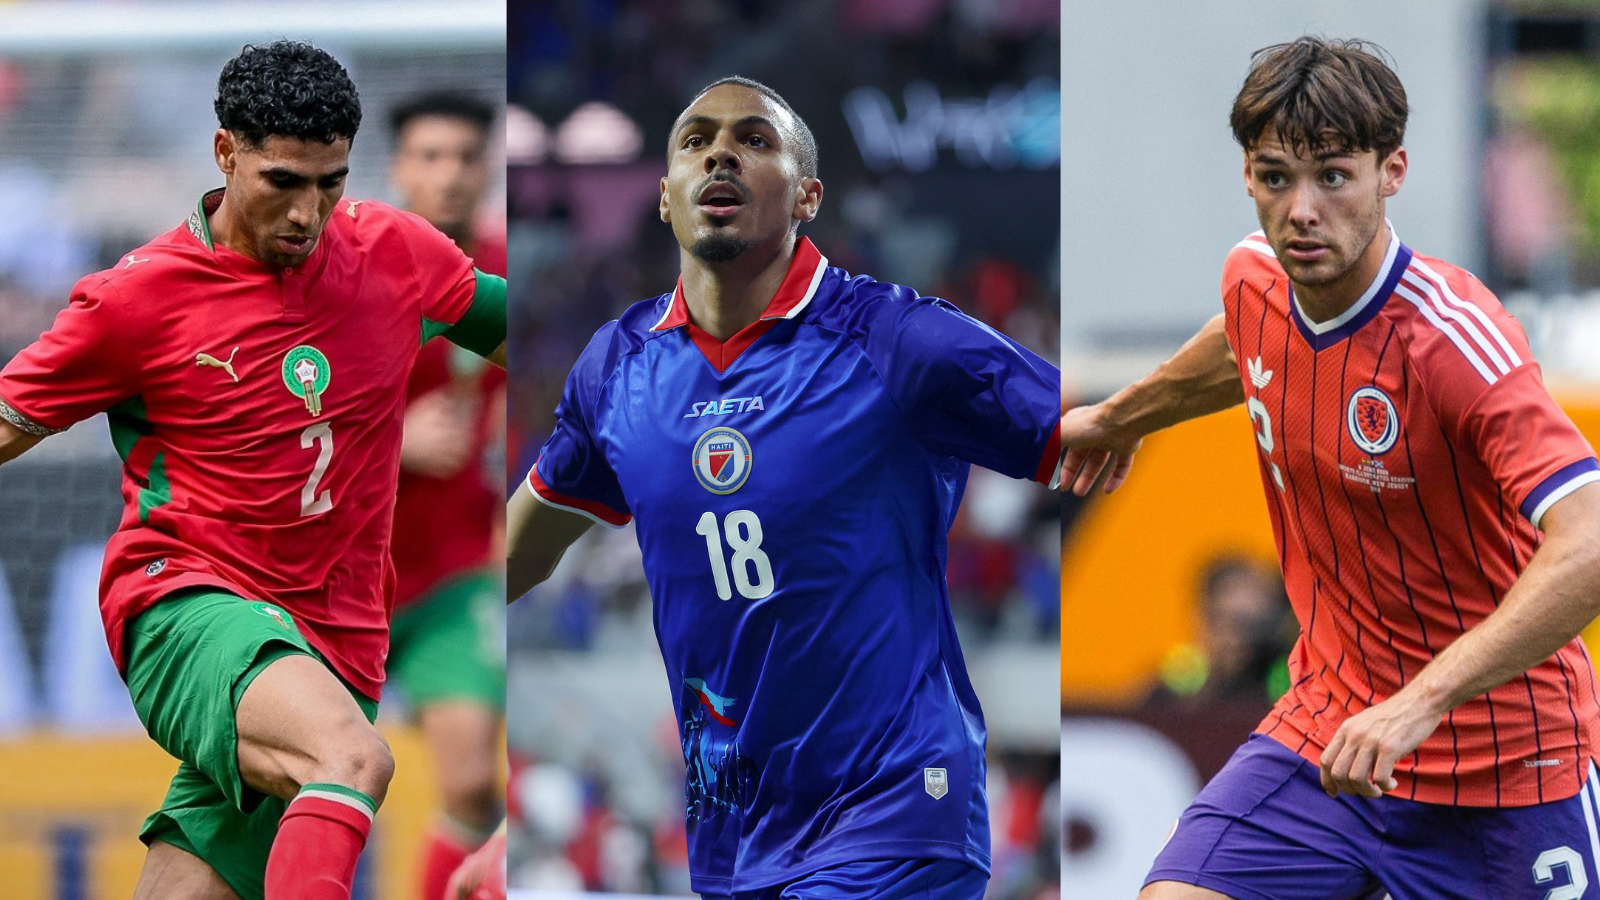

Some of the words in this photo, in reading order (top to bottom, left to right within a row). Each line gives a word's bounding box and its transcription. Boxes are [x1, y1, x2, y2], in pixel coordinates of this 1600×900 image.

[683, 396, 764, 418] SAETA
[300, 421, 334, 517] 2
[696, 509, 775, 601] 18
[1532, 846, 1589, 900] 2
